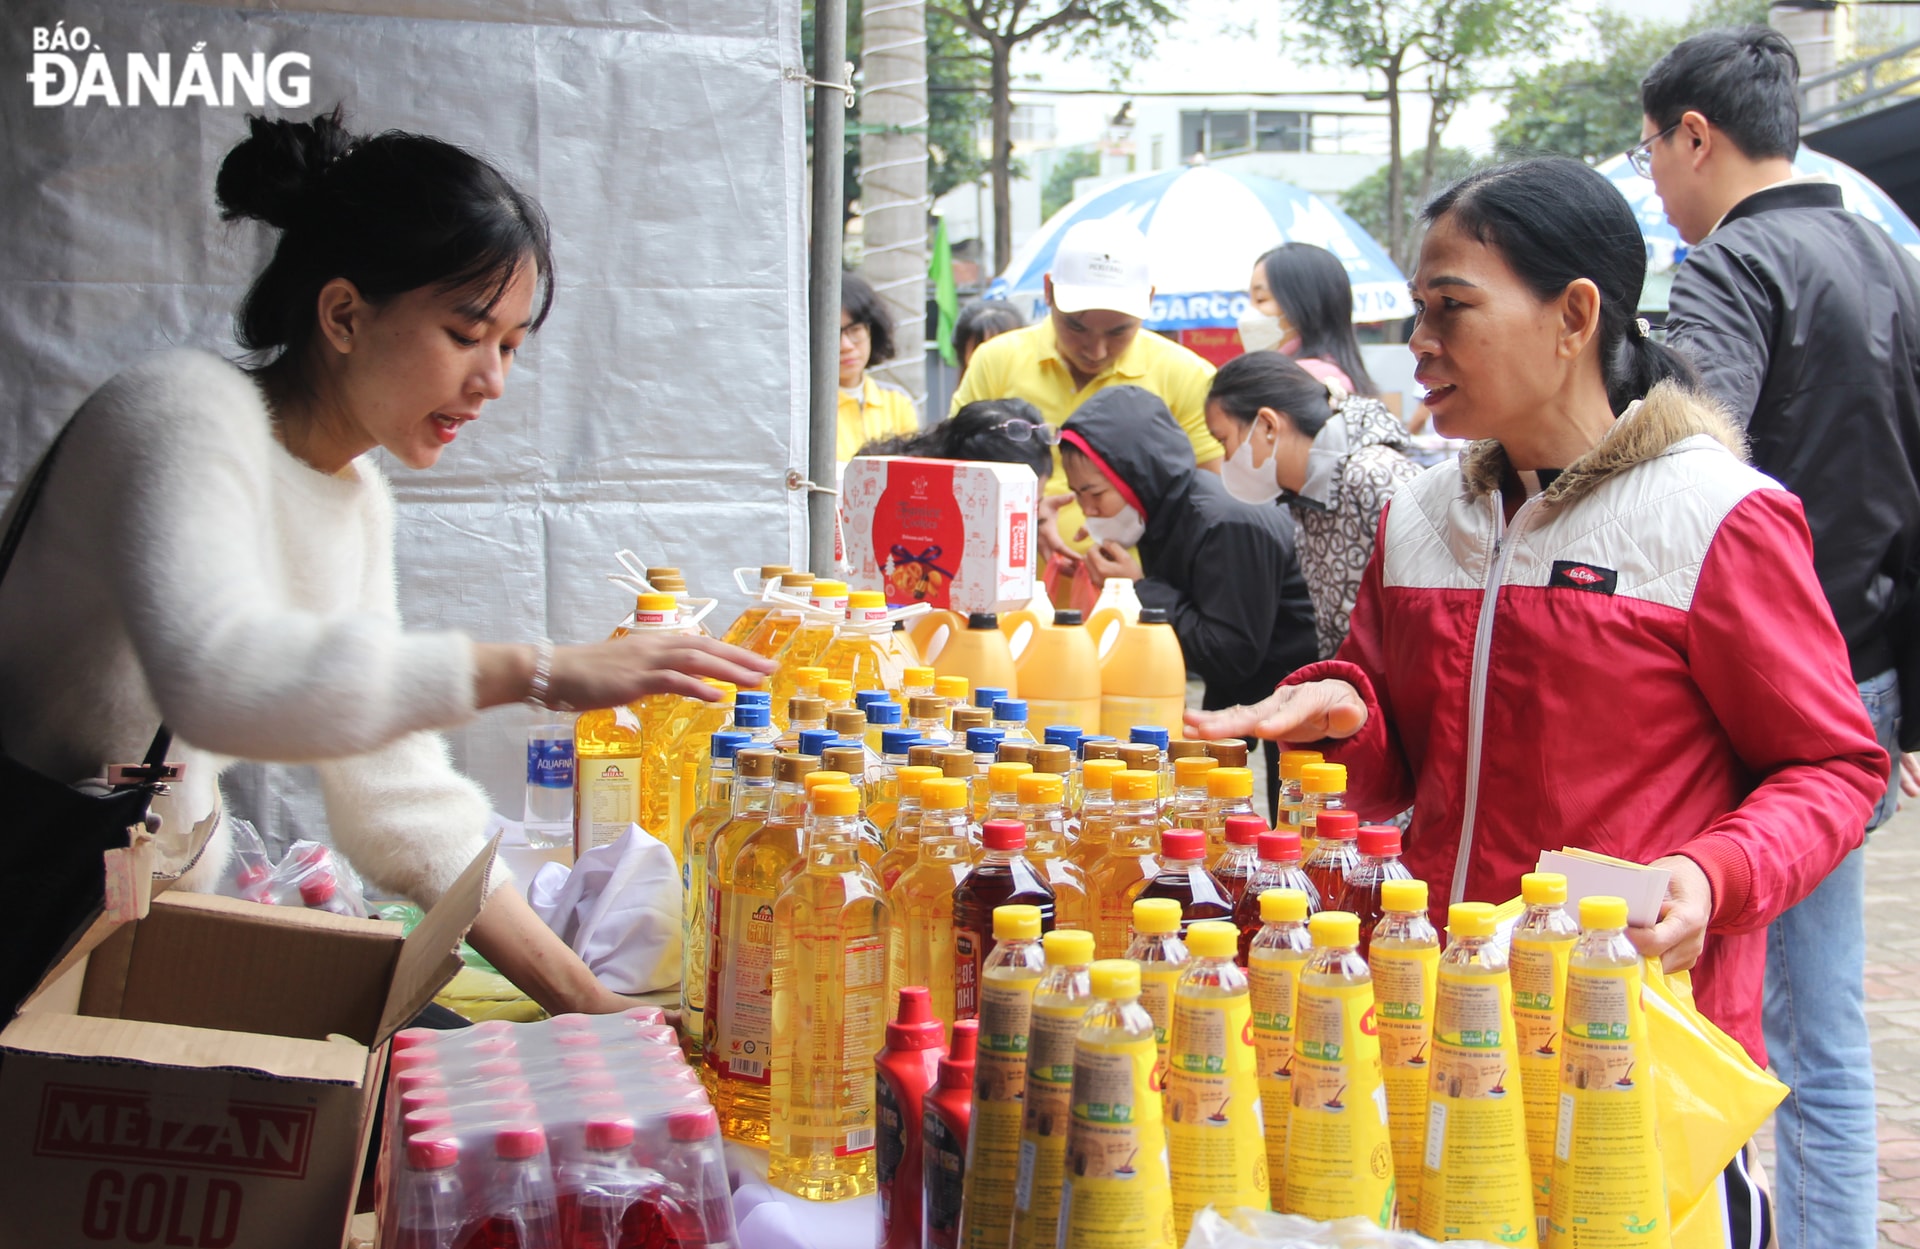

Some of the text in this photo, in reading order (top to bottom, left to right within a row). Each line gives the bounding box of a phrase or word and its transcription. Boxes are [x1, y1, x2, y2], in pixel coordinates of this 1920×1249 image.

[637, 613, 662, 622] Neptune
[537, 757, 573, 770] AQUAFINA
[52, 1100, 300, 1164] MEIZAN
[81, 1168, 243, 1249] GOLD
